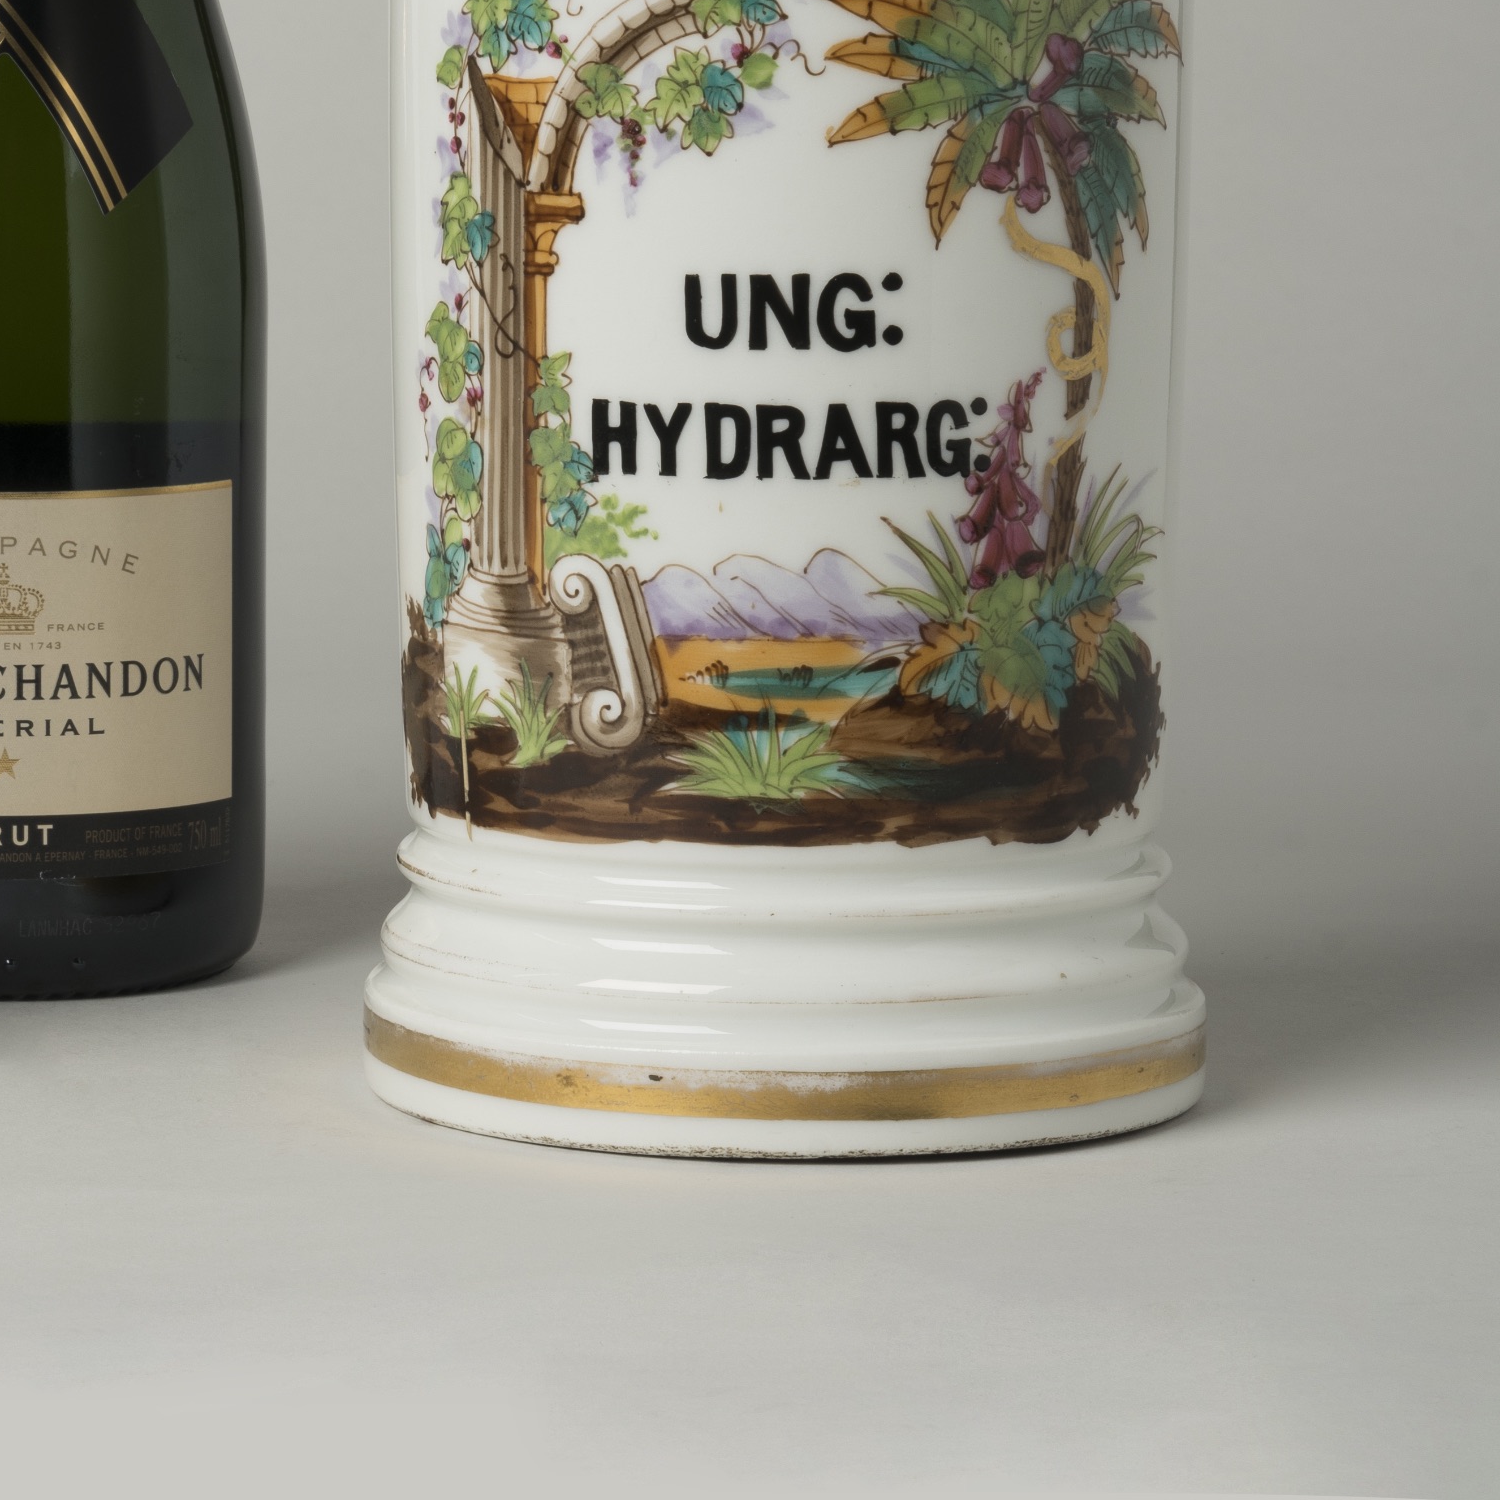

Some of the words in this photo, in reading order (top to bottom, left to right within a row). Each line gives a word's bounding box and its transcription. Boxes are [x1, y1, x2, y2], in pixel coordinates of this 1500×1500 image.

[684, 272, 904, 352] UNG:
[591, 396, 992, 481] HYDRARG:
[46, 622, 105, 632] FRANCE
[3, 641, 22, 651] EN
[29, 641, 62, 651] 1743
[85, 827, 132, 844] PRODUCT
[134, 826, 147, 841] OF
[149, 822, 184, 839] FRANCE
[187, 819, 207, 852] 750
[210, 816, 222, 847] ml
[44, 850, 86, 862] EPERNAY
[94, 848, 129, 860] FRANCE
